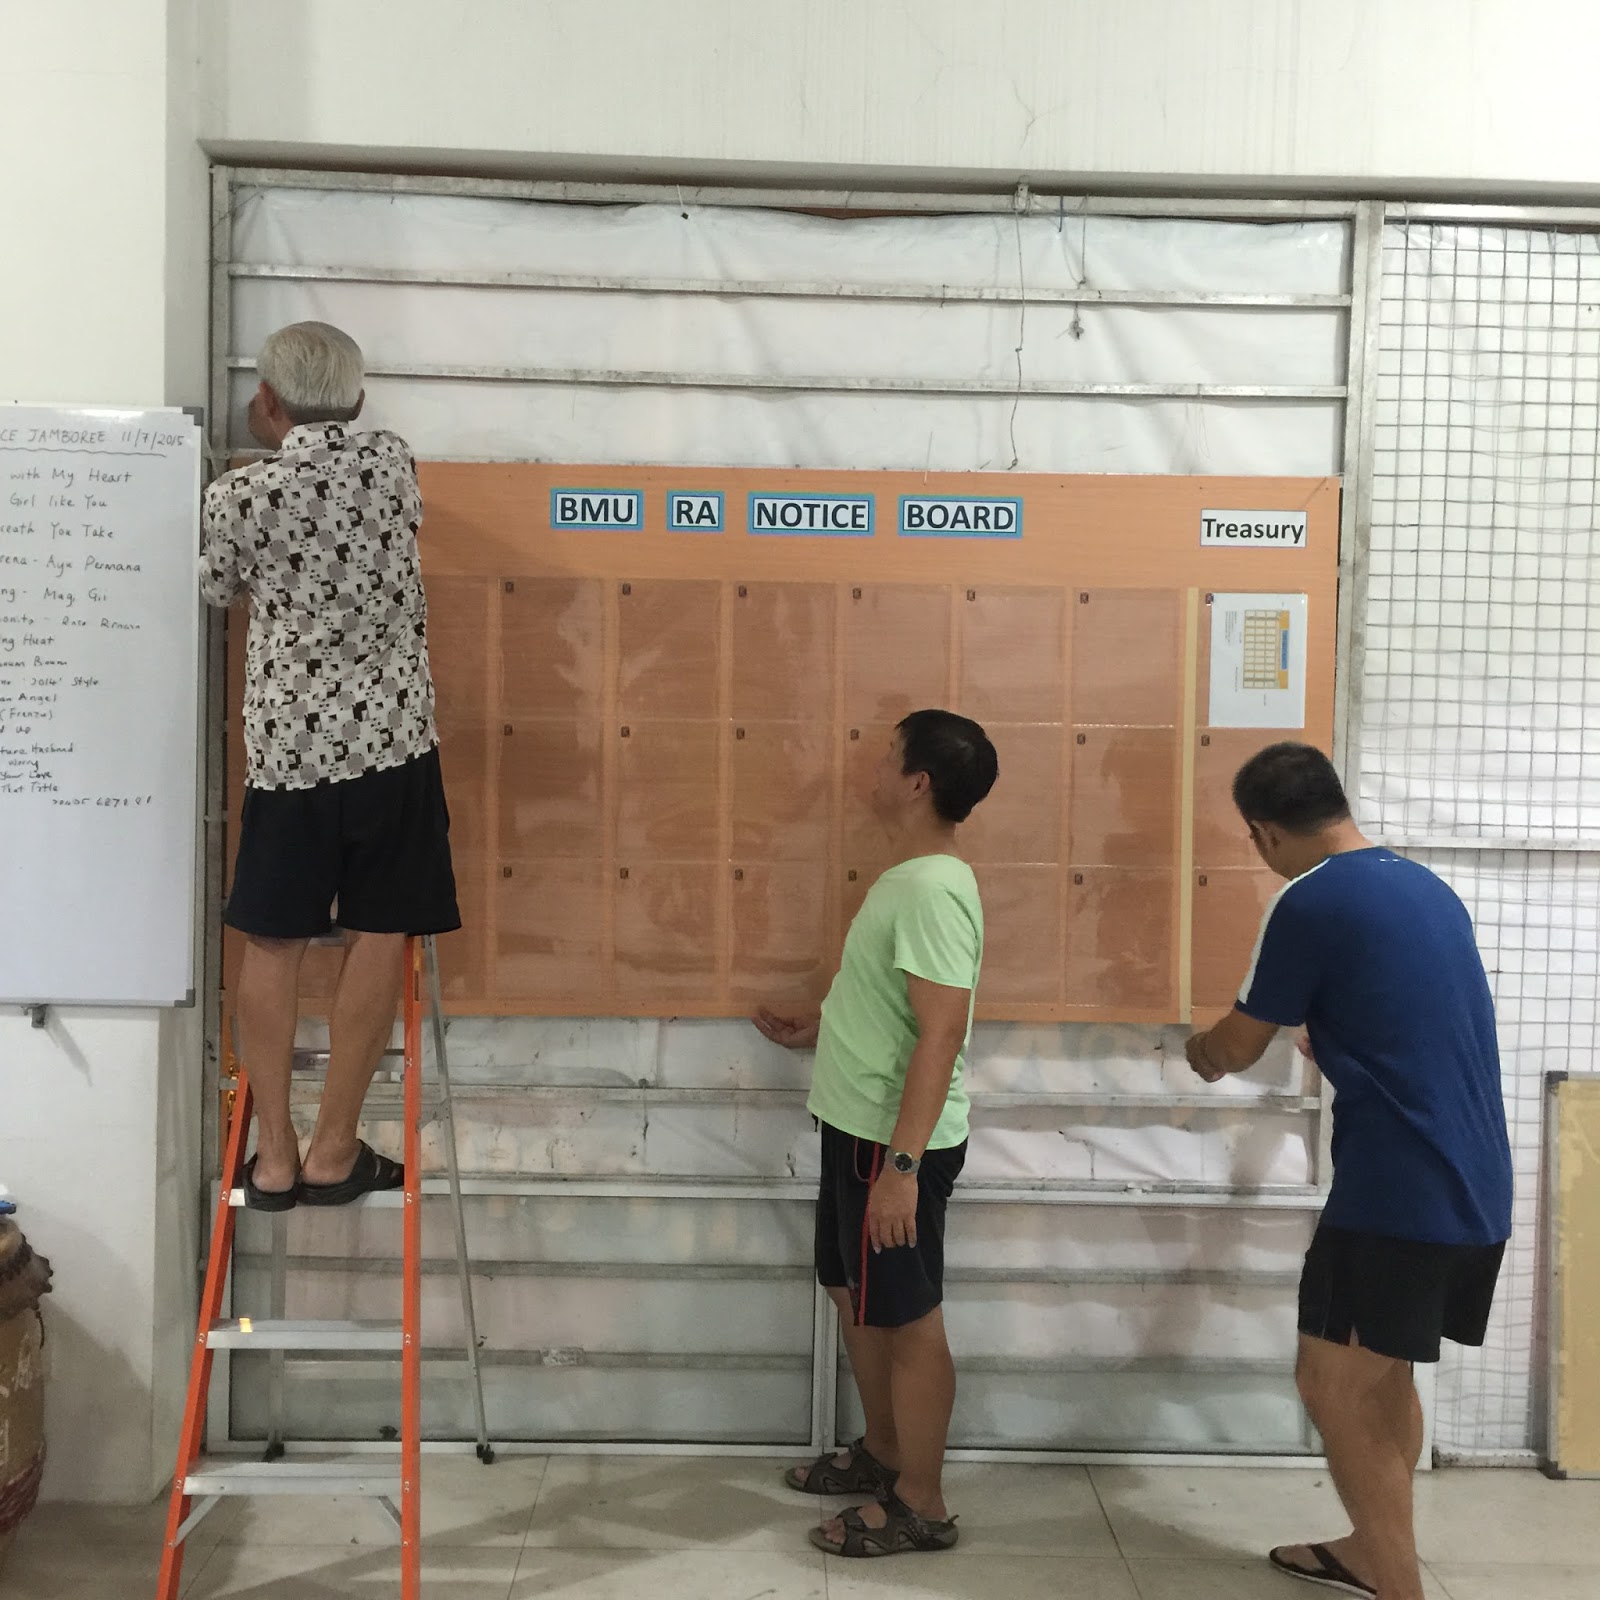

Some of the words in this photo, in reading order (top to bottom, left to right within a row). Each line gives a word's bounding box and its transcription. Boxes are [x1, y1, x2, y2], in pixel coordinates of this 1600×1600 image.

[28, 428, 106, 444] JAMBOREE
[121, 429, 185, 449] 11/7/2015
[10, 467, 40, 481] with
[52, 469, 74, 488] My
[89, 468, 132, 483] Heart
[10, 492, 35, 507] Girl
[85, 494, 108, 509] You
[559, 496, 634, 523] BMU
[675, 500, 718, 525] RA
[756, 502, 866, 529] NOTICE
[907, 504, 1015, 531] BOARD
[50, 521, 72, 540] You
[82, 524, 114, 538] Take
[1202, 518, 1304, 544] Treasury
[85, 555, 141, 573] Permana
[23, 633, 55, 646] Huat
[18, 692, 57, 706] Angel
